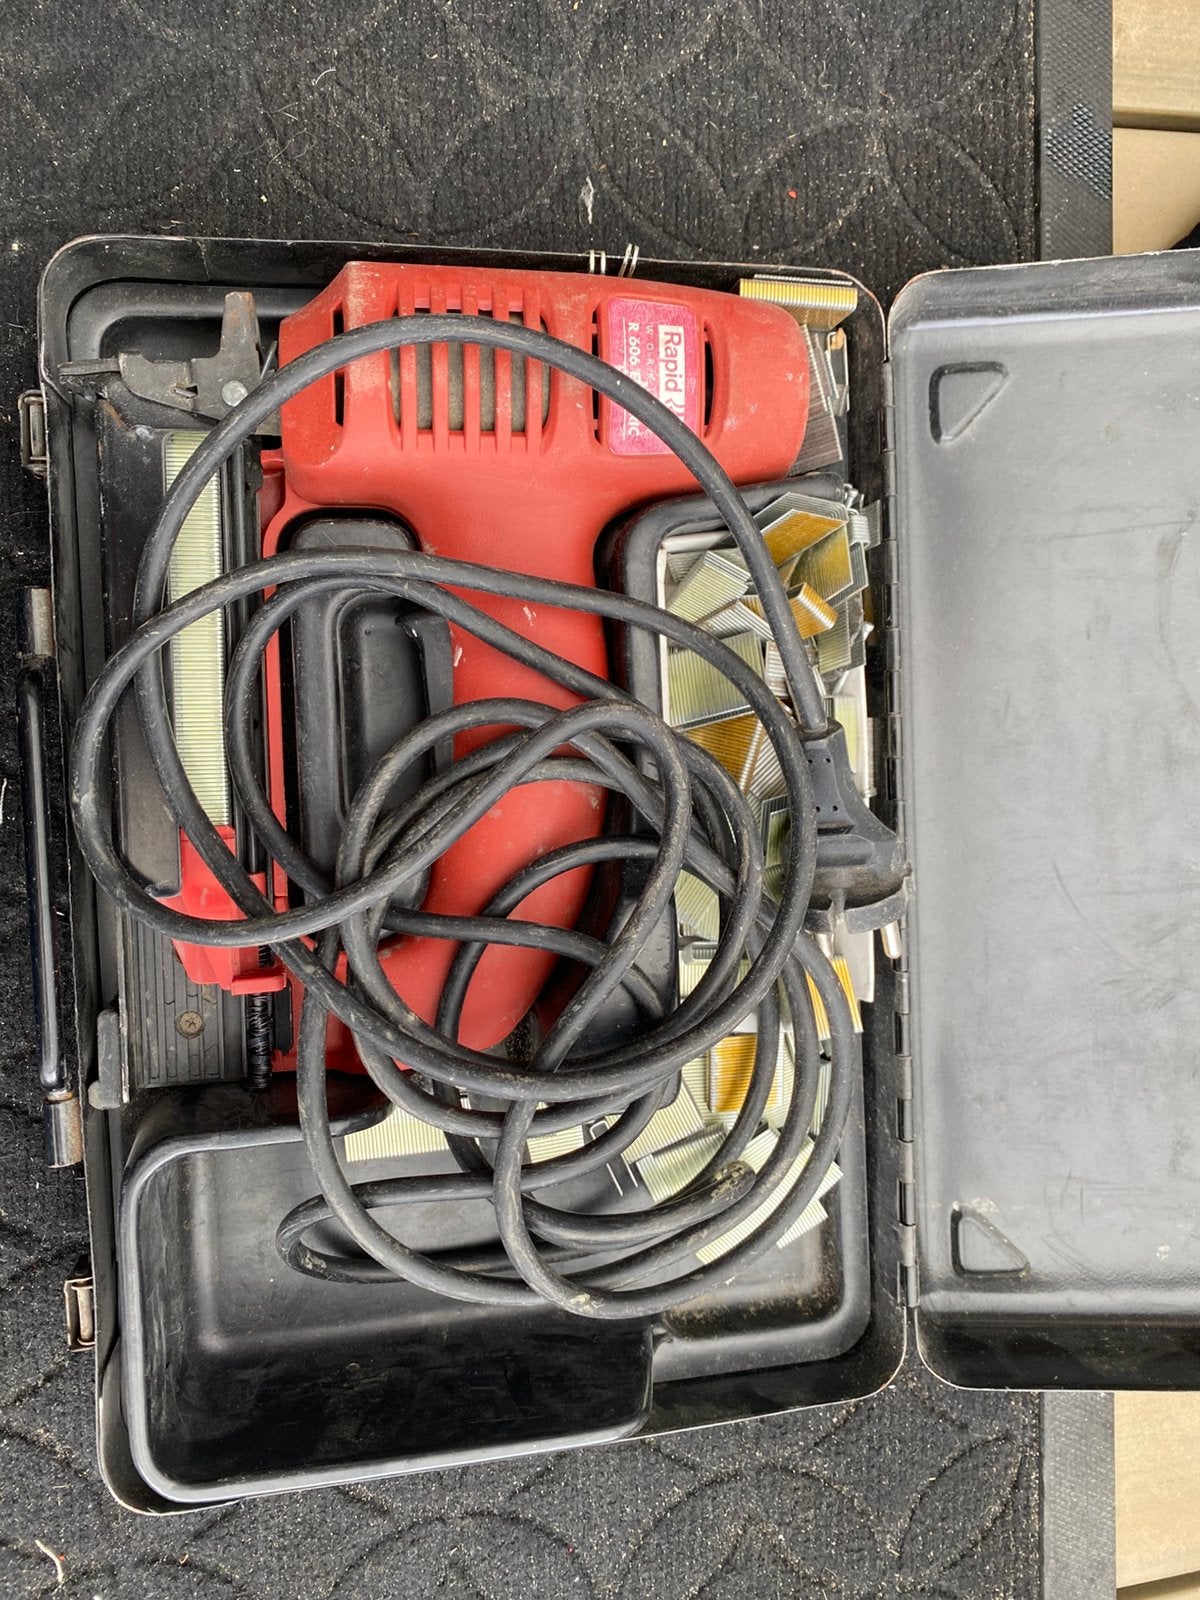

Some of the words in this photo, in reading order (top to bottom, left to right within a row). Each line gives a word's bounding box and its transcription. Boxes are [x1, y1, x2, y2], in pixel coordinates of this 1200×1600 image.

[628, 322, 640, 331] R
[628, 336, 641, 366] 606
[660, 331, 683, 393] Rapid
